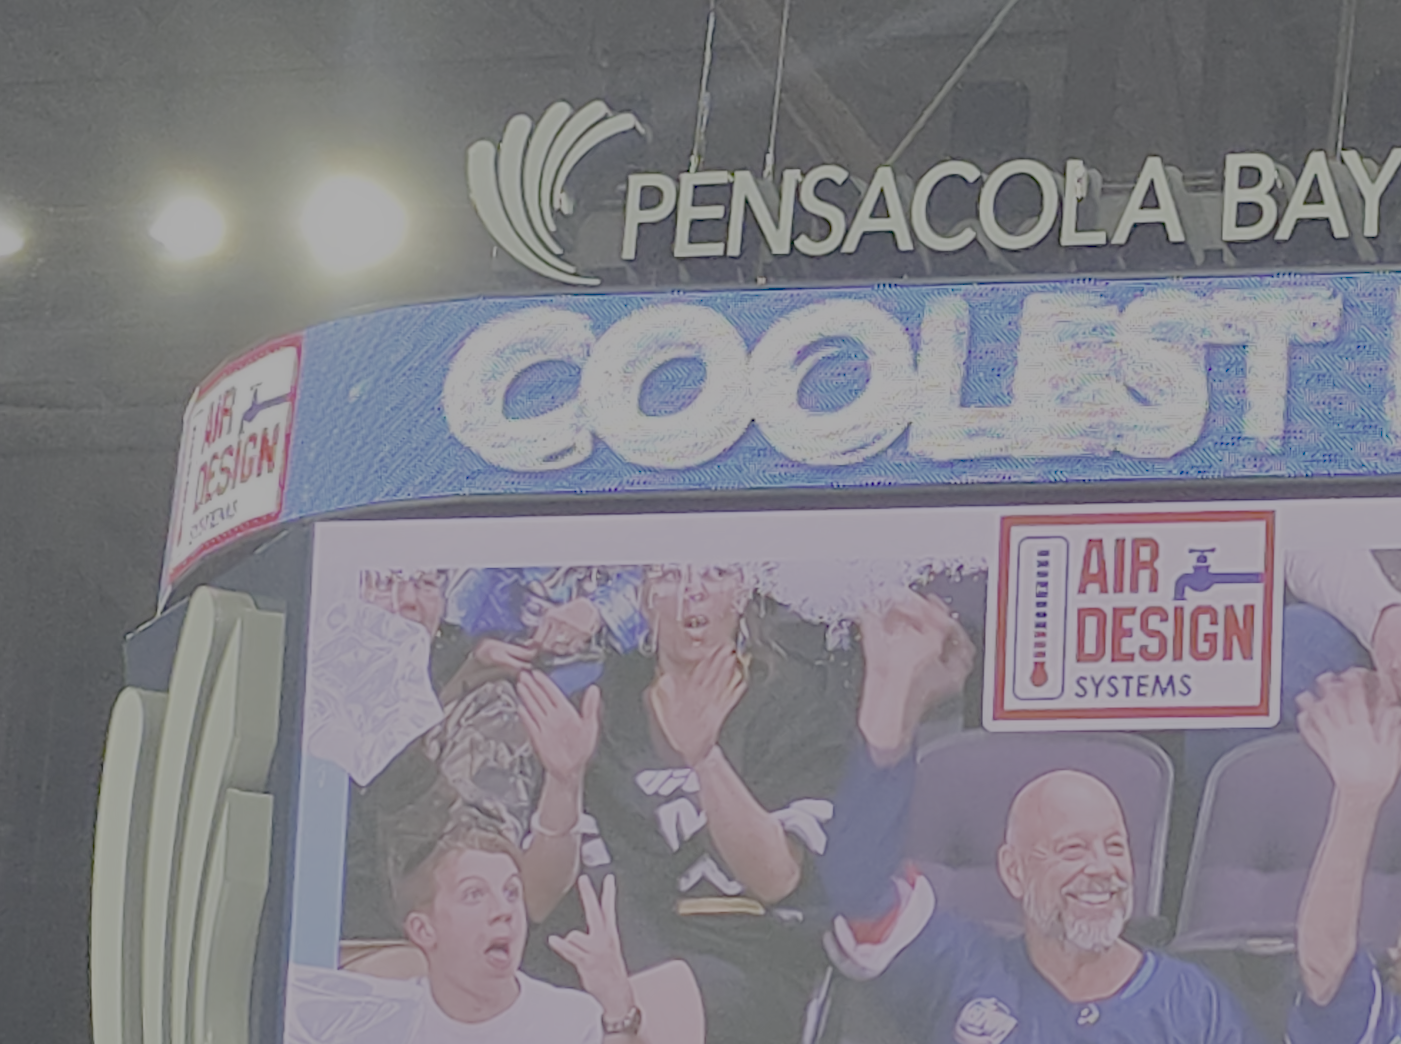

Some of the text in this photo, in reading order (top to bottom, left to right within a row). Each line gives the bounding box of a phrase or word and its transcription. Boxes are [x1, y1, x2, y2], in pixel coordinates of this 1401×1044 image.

[620, 157, 1187, 261] PENSACOLA
[442, 287, 1344, 472] COOLEST
[201, 386, 236, 455] AIR
[1077, 536, 1160, 596] AIR
[1075, 603, 1255, 663] DESIGN
[1074, 673, 1193, 699] SYSTEMS
